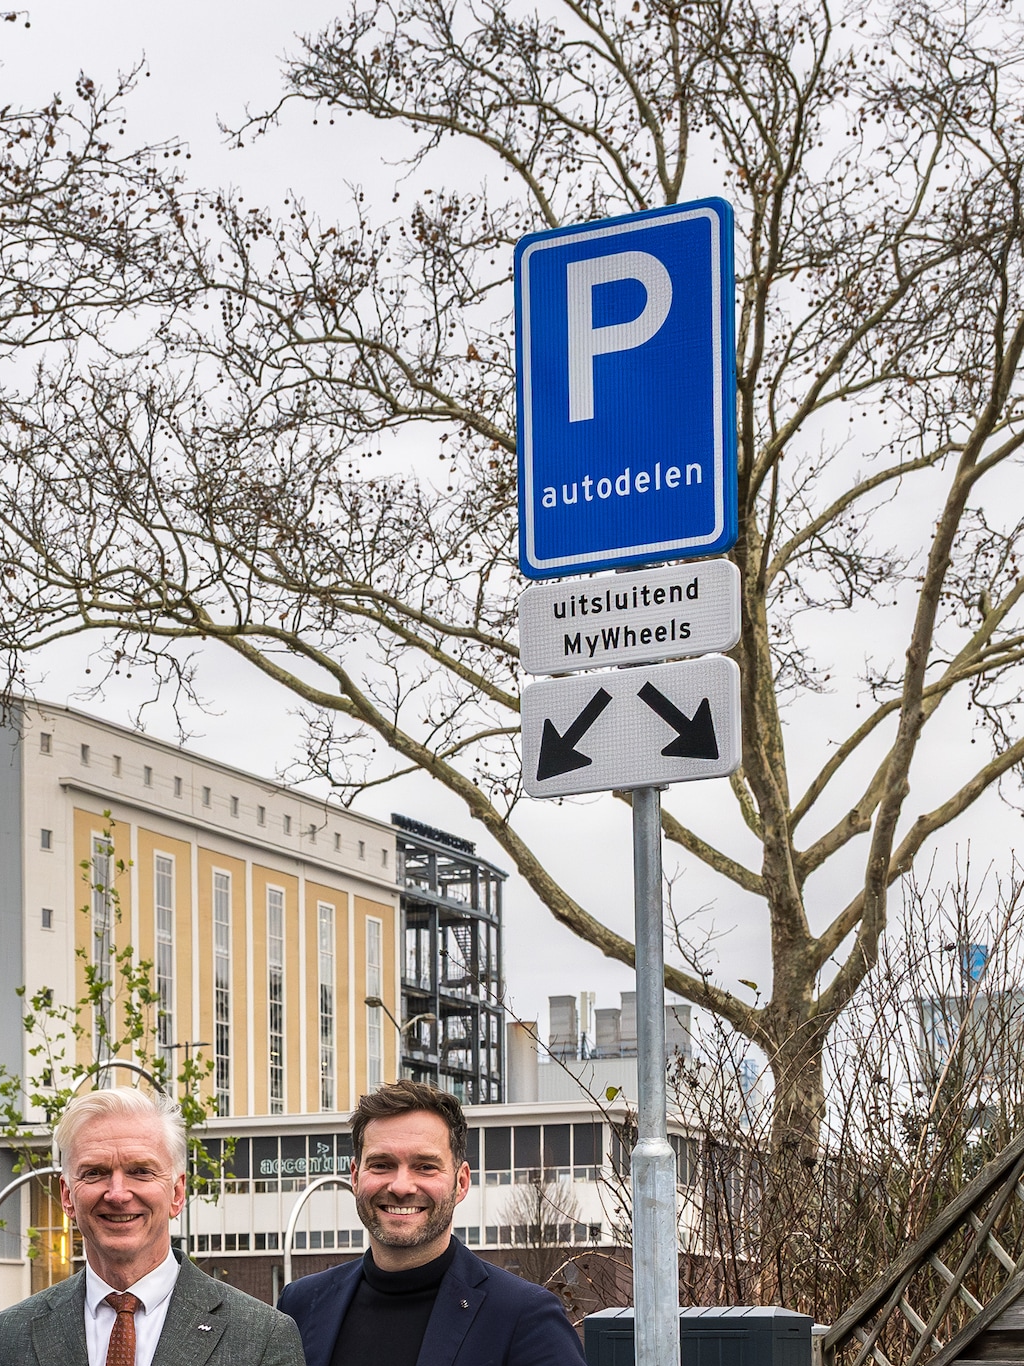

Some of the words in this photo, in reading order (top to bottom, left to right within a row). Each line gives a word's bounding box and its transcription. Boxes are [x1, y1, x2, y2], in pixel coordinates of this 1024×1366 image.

[567, 251, 672, 422] P
[542, 462, 703, 509] autodelen
[553, 577, 700, 619] uitsluitend
[564, 619, 692, 658] MyWheels
[260, 1154, 355, 1174] accentur
